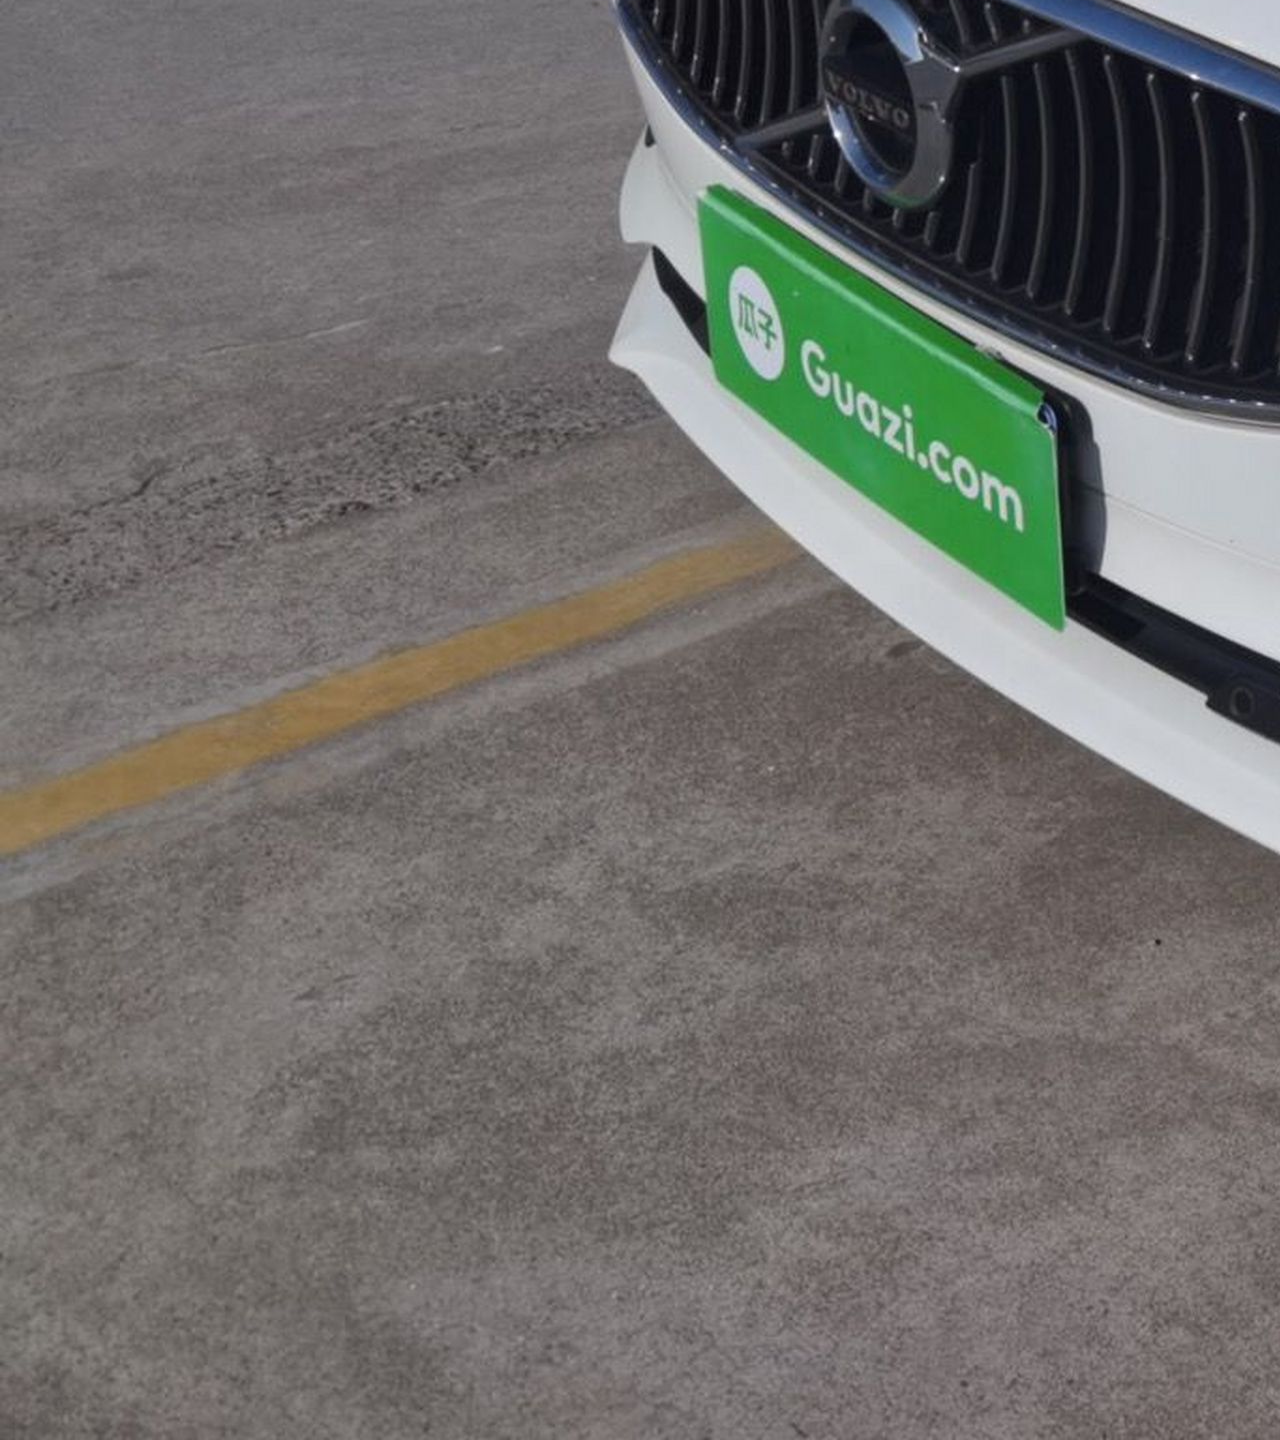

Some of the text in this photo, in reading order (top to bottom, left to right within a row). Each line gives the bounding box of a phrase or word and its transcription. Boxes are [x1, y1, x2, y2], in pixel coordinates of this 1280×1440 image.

[823, 67, 911, 130] VOLVO
[738, 291, 778, 351] 瓜子
[800, 339, 1026, 534] Guazi.com
